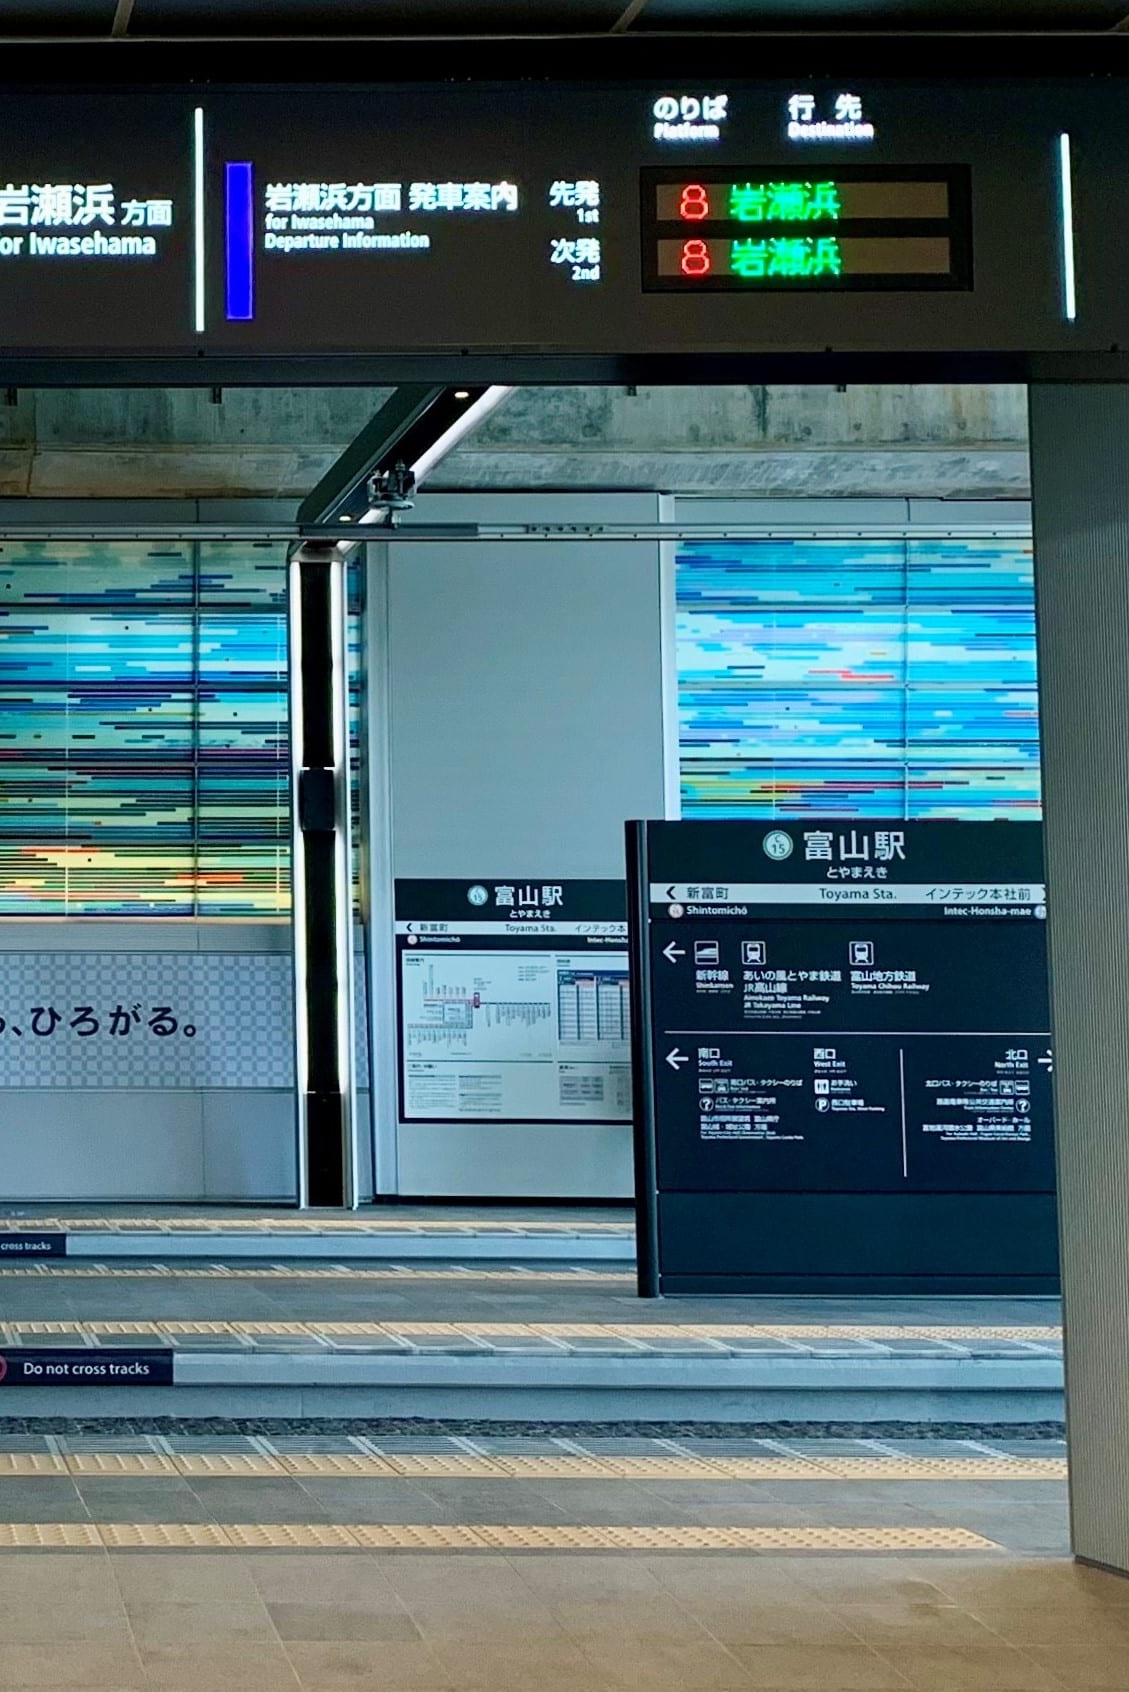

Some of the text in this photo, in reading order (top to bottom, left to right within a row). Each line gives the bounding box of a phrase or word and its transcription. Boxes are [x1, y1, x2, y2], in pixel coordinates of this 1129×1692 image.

[653, 94, 729, 121] のりば
[653, 121, 720, 139] Platform
[788, 121, 874, 138] Destination
[265, 181, 519, 211] 岩瀬浜方面 発車案内
[549, 180, 601, 207] 先発
[680, 182, 841, 221] 8 岩瀬浜
[120, 199, 174, 226] 方面
[576, 209, 600, 224] 1st
[265, 213, 375, 231] for Iwasehama
[29, 231, 157, 255] Iwasehama
[264, 231, 431, 252] Departure Information
[550, 238, 601, 263] 次発
[681, 238, 842, 277] 8 岩瀬浜
[571, 265, 600, 281] 2nd
[772, 844, 786, 855] 15
[803, 829, 906, 861] 富山駅
[826, 866, 888, 879] とやまえき
[494, 884, 564, 907] 富山駅
[686, 886, 730, 901] 新富町
[819, 887, 897, 902] Toyama Sta.
[925, 887, 1032, 901] インテック本社前
[509, 909, 552, 920] とやまえき
[944, 905, 1032, 917] Intec-Honsha-mae
[505, 923, 538, 935] Toyama
[695, 969, 729, 982] 新幹線
[743, 969, 842, 982] あいの風とやま鉄道
[1005, 1048, 1028, 1061] 北口
[0, 1242, 22, 1251] cross
[23, 1240, 52, 1251] tracks
[23, 1362, 150, 1376] Do not cross tracks
